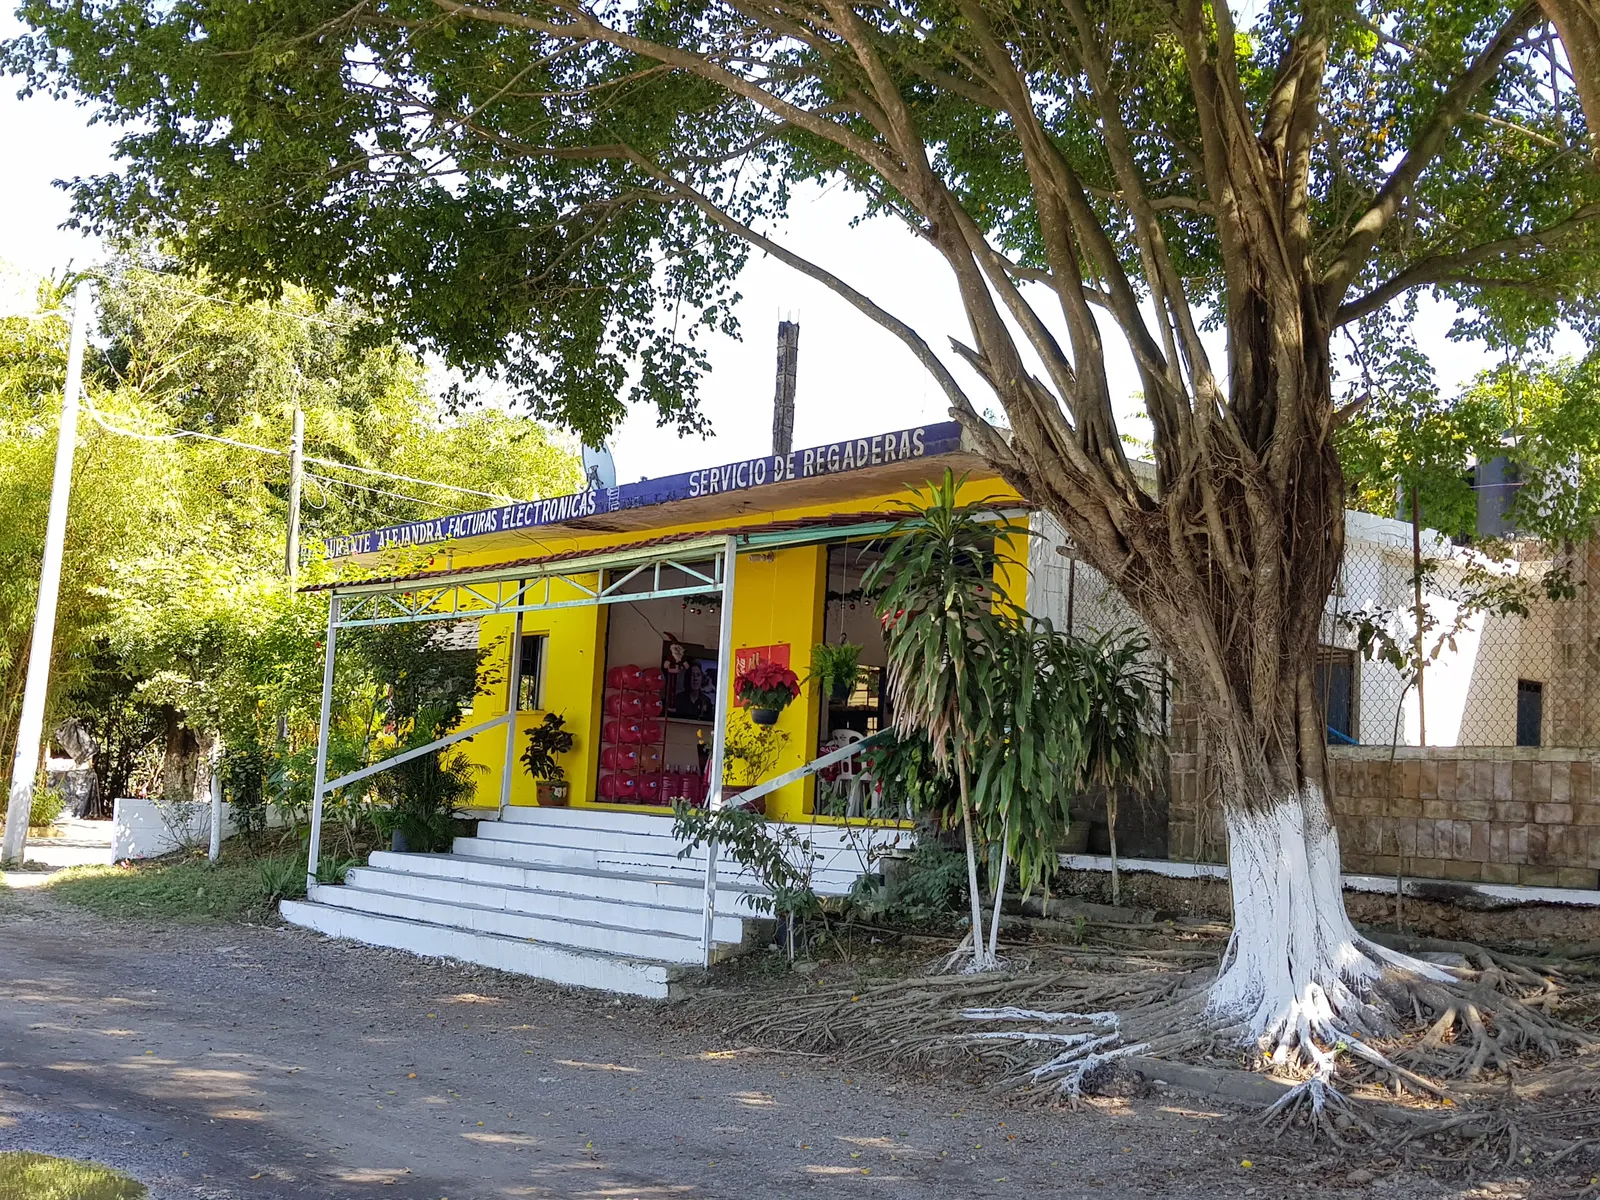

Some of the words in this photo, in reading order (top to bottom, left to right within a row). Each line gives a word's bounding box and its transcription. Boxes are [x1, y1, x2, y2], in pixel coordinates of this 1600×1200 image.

[689, 459, 767, 497] SERVICIO
[773, 452, 796, 482] DE
[803, 428, 926, 477] REGADERAS
[448, 510, 498, 537] FACTURAS
[502, 491, 597, 530] ELECTRONICAS
